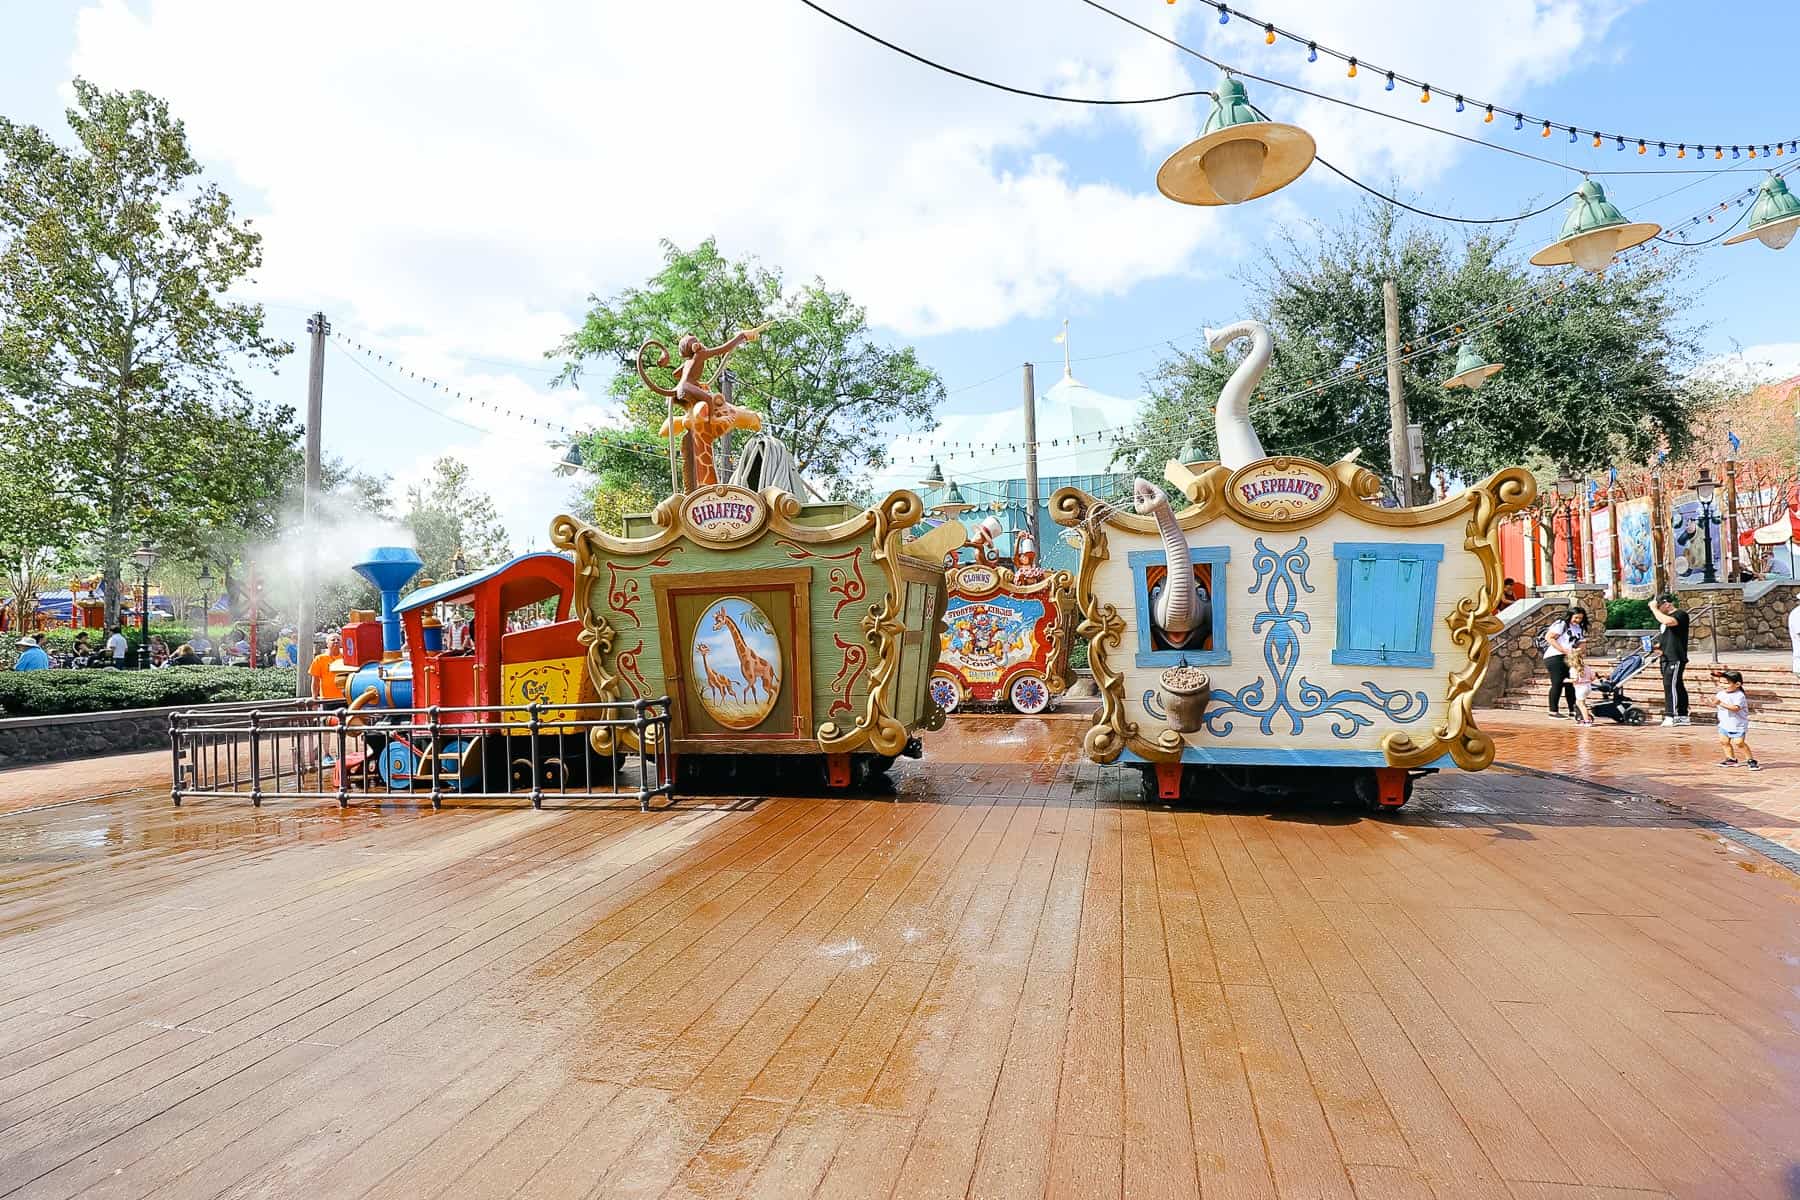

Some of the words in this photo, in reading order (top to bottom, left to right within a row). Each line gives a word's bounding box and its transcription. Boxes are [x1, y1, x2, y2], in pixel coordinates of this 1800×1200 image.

[1240, 478, 1324, 503] ELEPHANTS
[692, 502, 754, 525] GIRAFFES
[963, 573, 991, 584] CLOWNS
[521, 679, 548, 701] Casey
